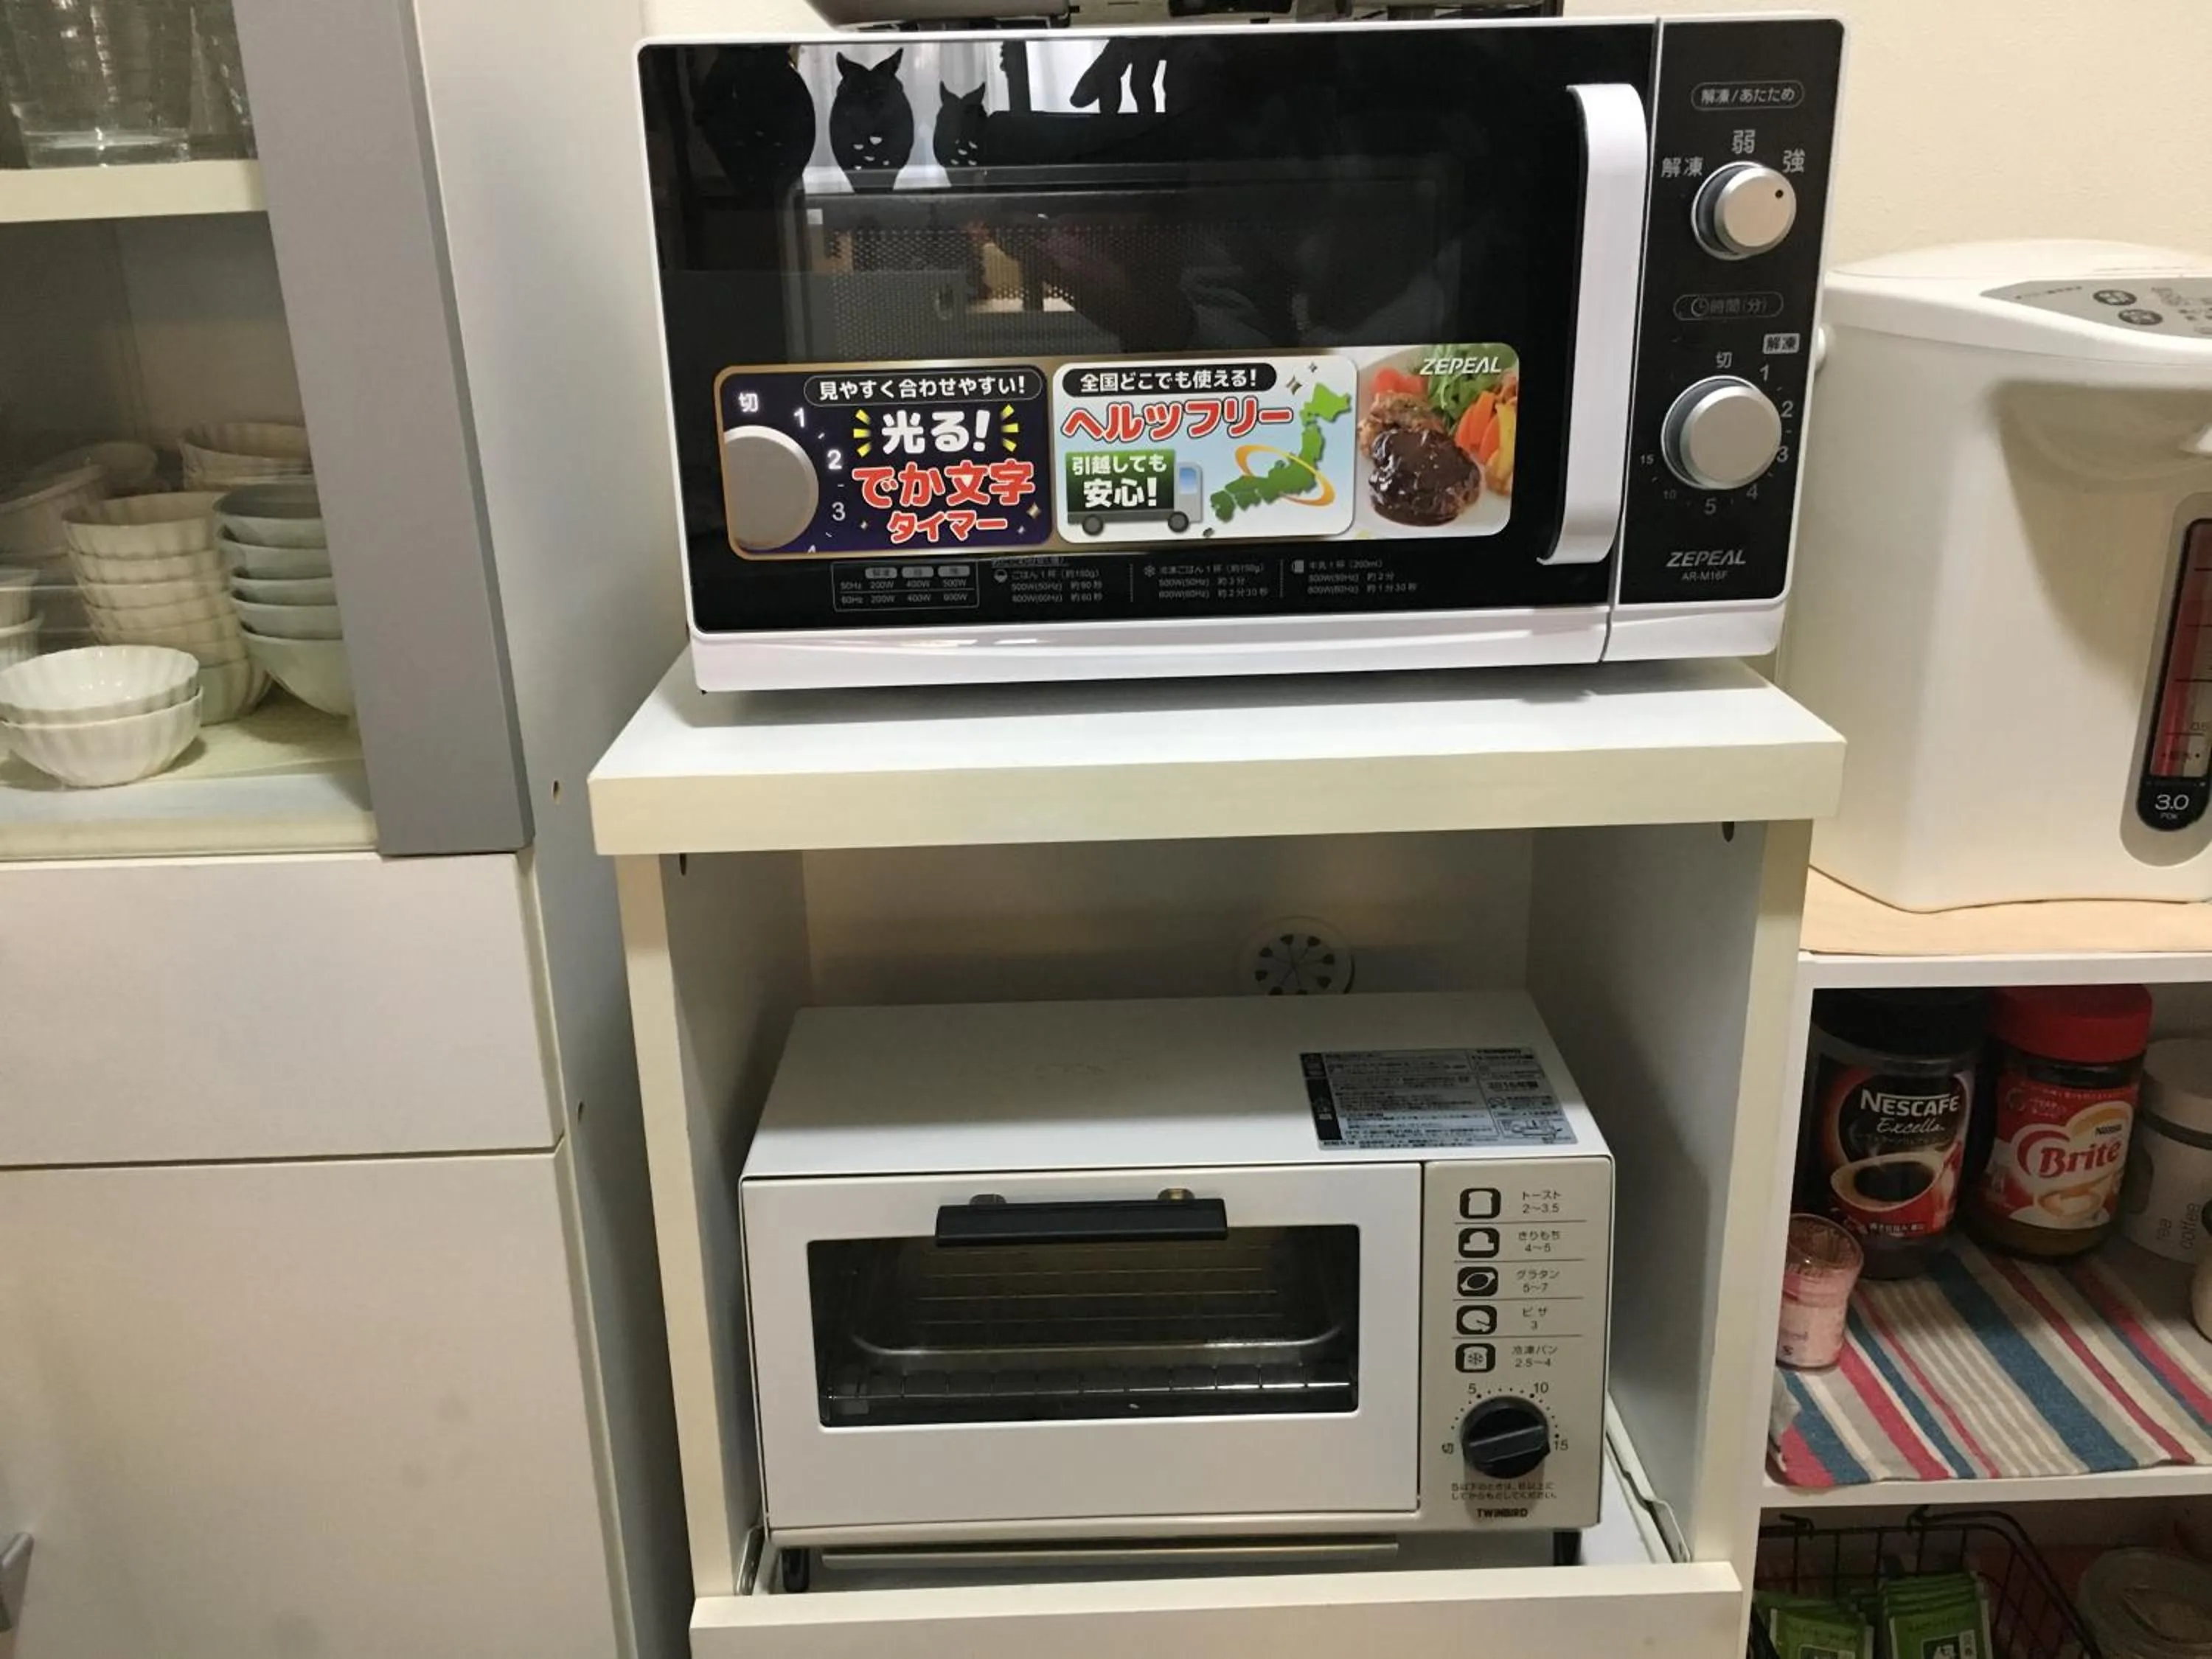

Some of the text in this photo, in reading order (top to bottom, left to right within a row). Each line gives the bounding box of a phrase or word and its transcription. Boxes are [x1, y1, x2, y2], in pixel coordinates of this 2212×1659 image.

[1732, 129, 1756, 154] 弱
[1661, 156, 1704, 178] 解凍
[1782, 149, 1806, 173] 強
[1419, 356, 1502, 375] ZEPEAL
[1715, 351, 1732, 369] 切
[1079, 369, 1257, 393] 全国どこでも使える!
[1759, 364, 1770, 381] 1
[819, 375, 1027, 401] 見やすく合わせやすい!
[738, 392, 759, 413] 切
[1781, 400, 1794, 418] 2
[793, 407, 805, 428] 1
[1061, 396, 1295, 442] ヘルツフリー
[881, 409, 991, 454] 光る!
[827, 449, 842, 470] 2
[1071, 453, 1167, 476] 引越しても
[1776, 446, 1789, 463] 3
[852, 458, 1036, 509] でか文字
[1083, 477, 1158, 508] 安心!
[1746, 484, 1759, 500] 4
[831, 501, 846, 521] 3
[1704, 498, 1717, 515] 5
[886, 509, 1008, 543] タイマー
[1666, 550, 1747, 568] ZEPEAL
[2154, 794, 2190, 811] 3.0
[2039, 1141, 2122, 1178] Brite
[1523, 1189, 1562, 1201] トースト
[1516, 1269, 1560, 1280] グラタン
[1468, 1382, 1477, 1394] 5
[1533, 1382, 1549, 1394] 10
[1554, 1439, 1569, 1451] 15
